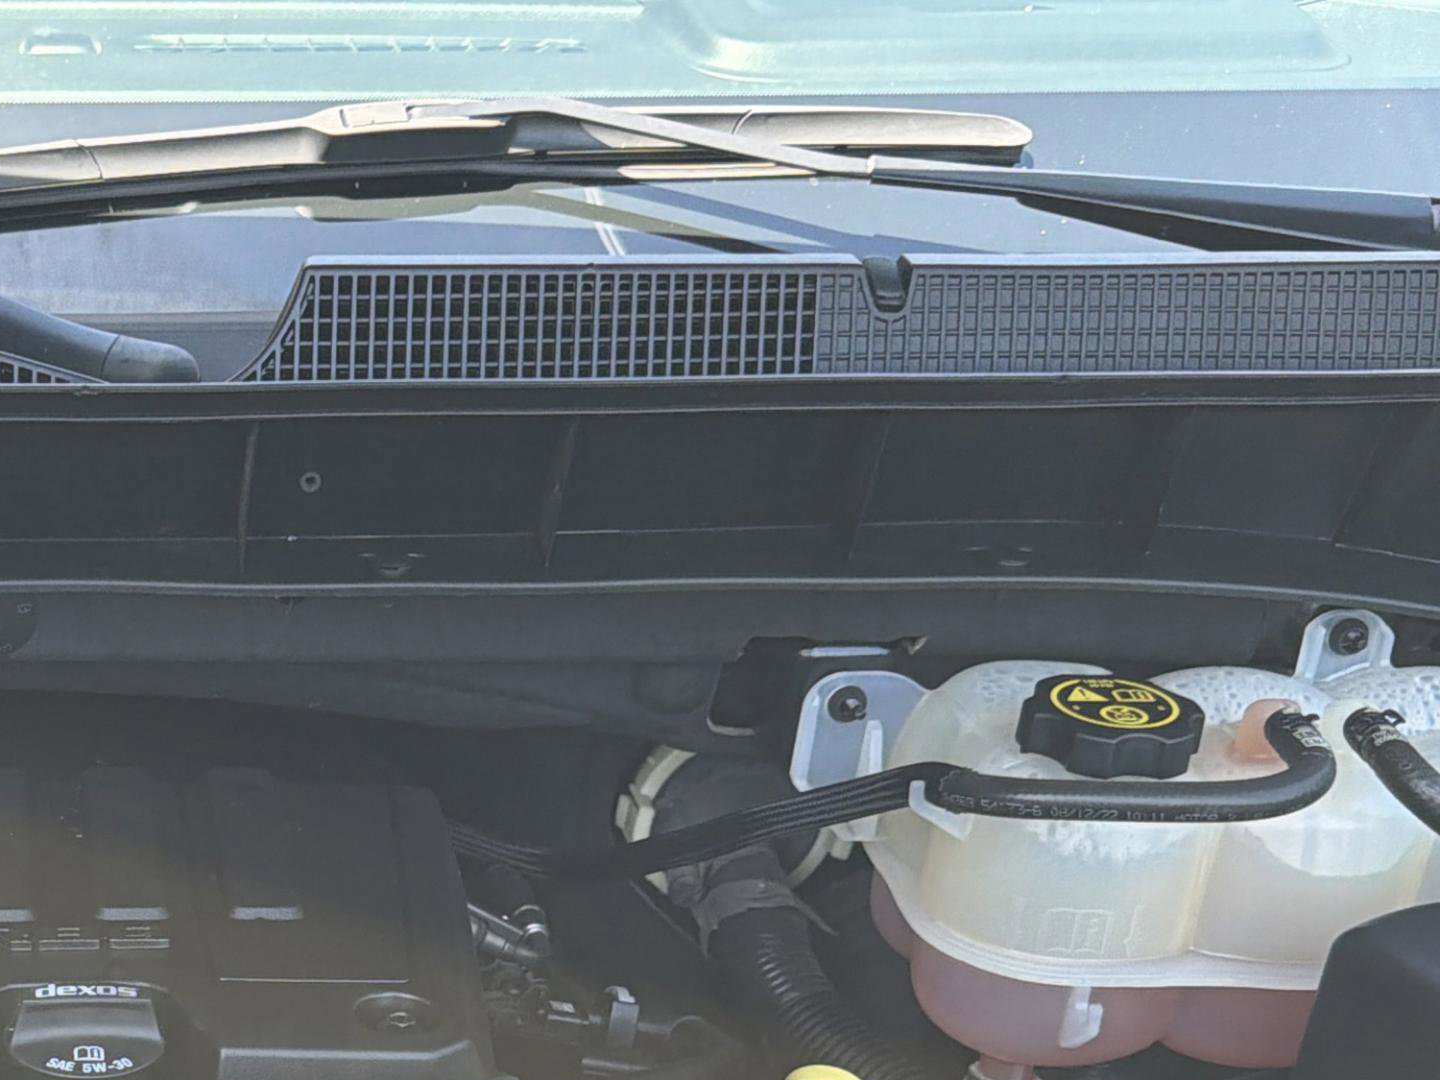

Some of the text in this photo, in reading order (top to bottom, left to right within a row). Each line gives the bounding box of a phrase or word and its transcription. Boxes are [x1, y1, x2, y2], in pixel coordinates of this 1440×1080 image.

[33, 983, 139, 999] dexos
[45, 1057, 134, 1074] SAE 5W-30
